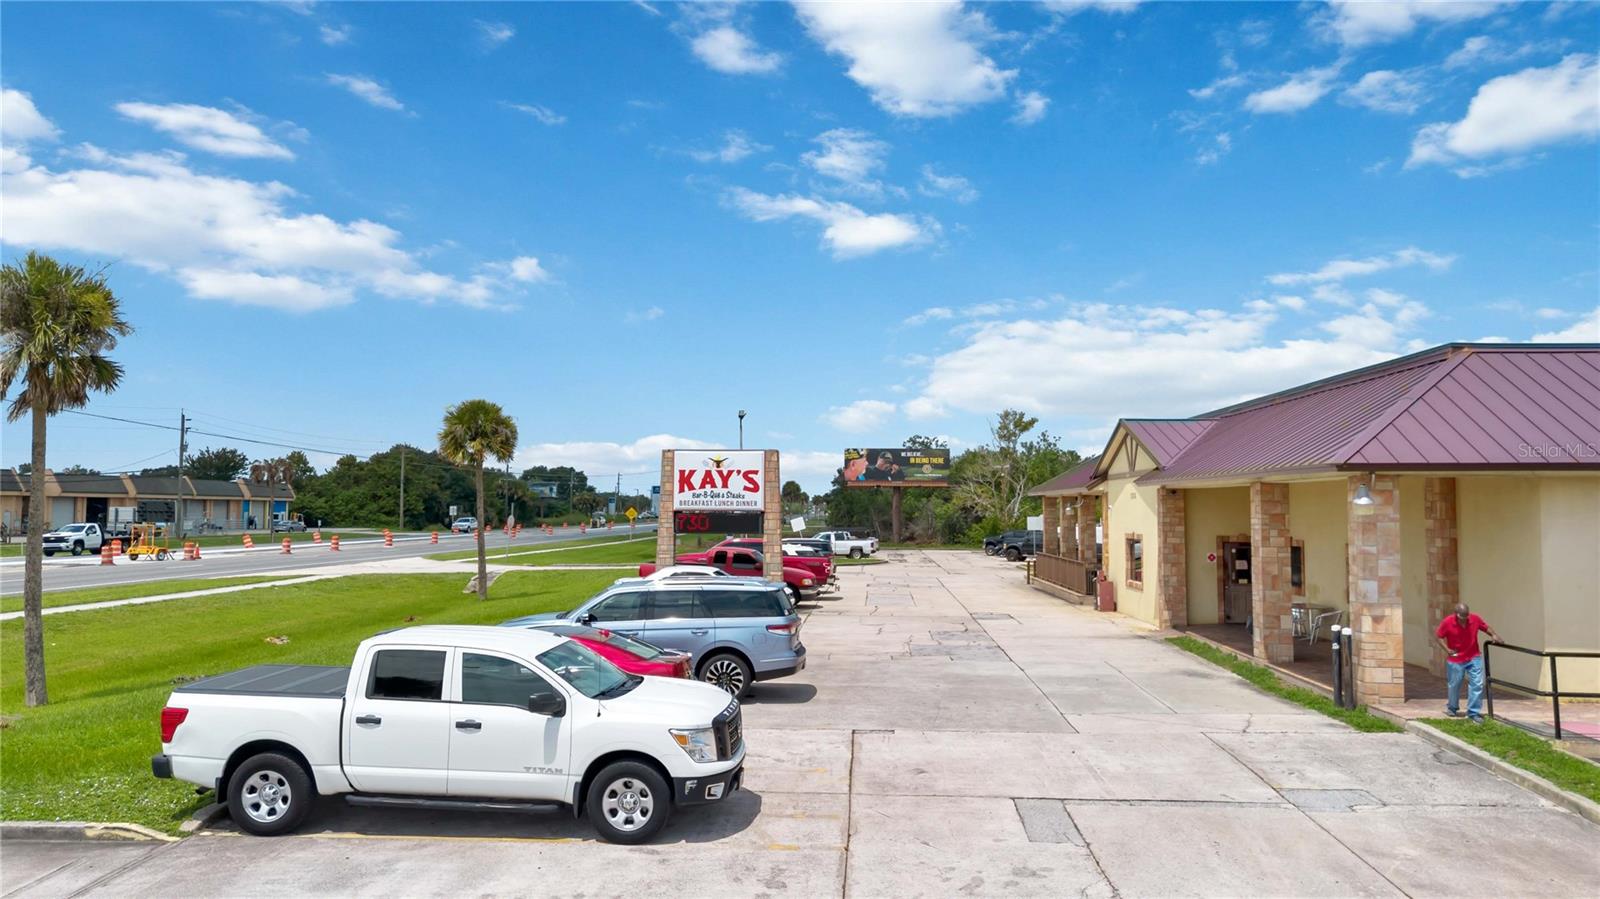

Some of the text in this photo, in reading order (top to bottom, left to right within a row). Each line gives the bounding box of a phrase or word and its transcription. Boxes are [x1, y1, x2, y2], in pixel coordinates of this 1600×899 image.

[678, 469, 760, 494] KAY'S
[726, 491, 745, 499] Steaks
[523, 766, 563, 775] TITAN
